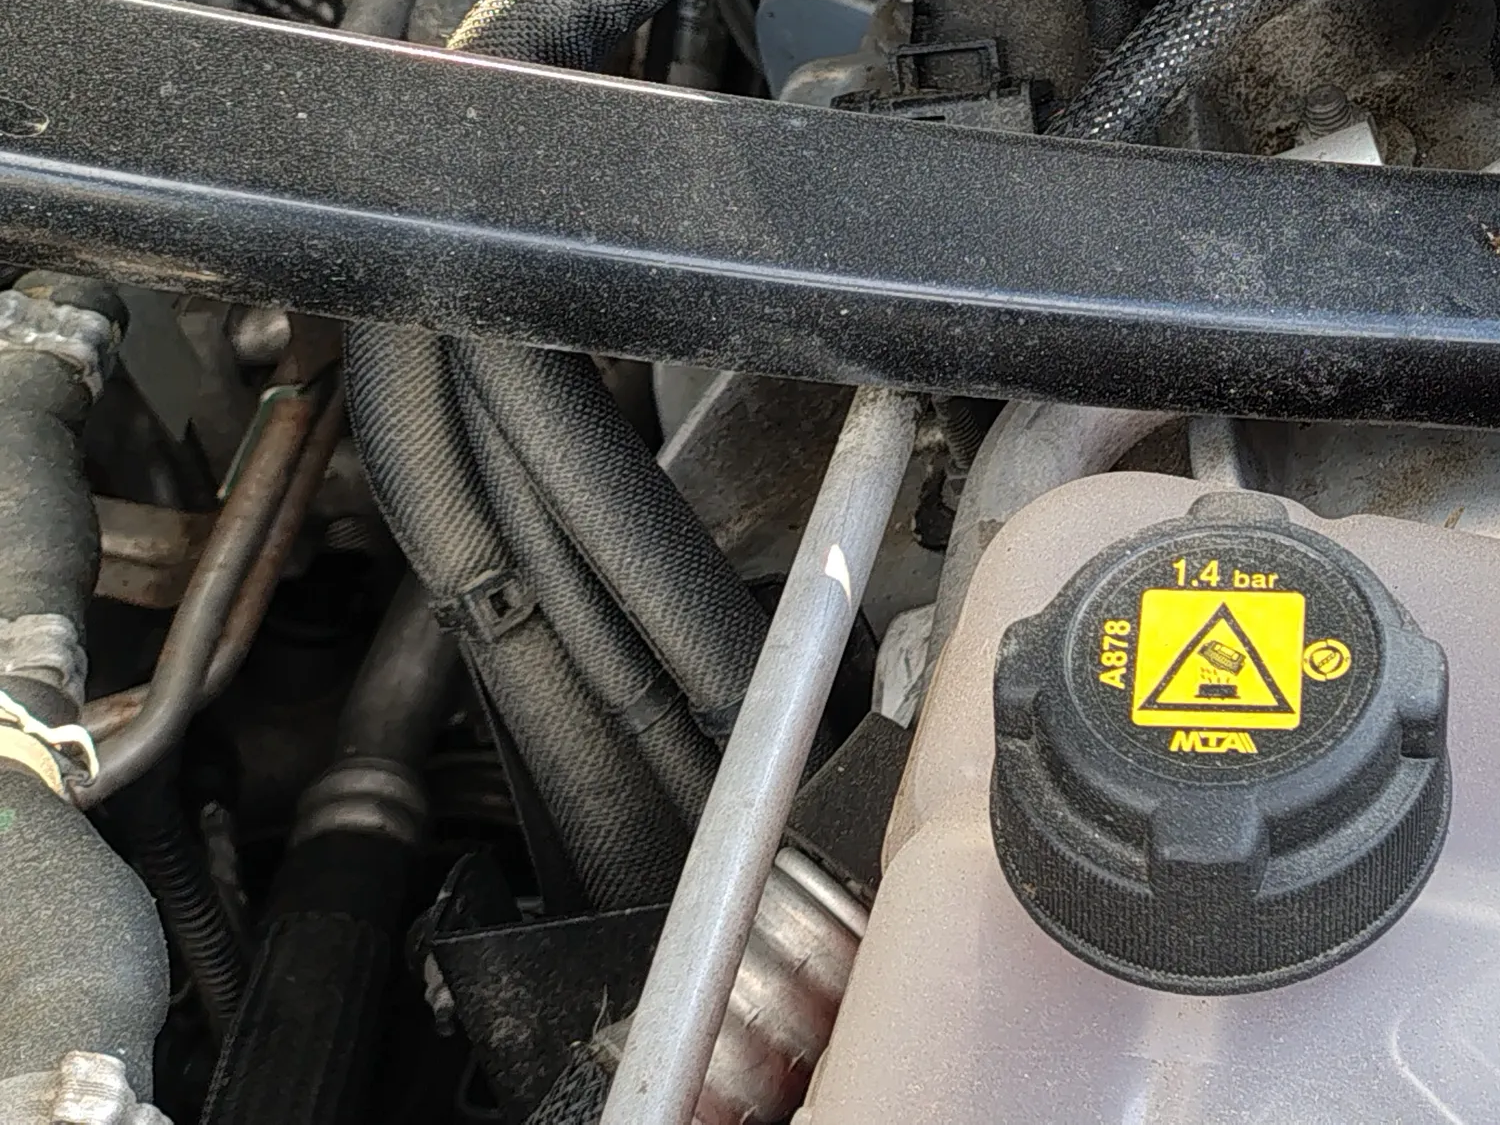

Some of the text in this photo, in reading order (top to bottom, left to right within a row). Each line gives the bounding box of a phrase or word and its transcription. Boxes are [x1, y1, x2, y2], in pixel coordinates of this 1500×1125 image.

[1173, 559, 1279, 588] 1.4 bar
[1099, 619, 1131, 689] A878
[1169, 730, 1258, 753] MTA
